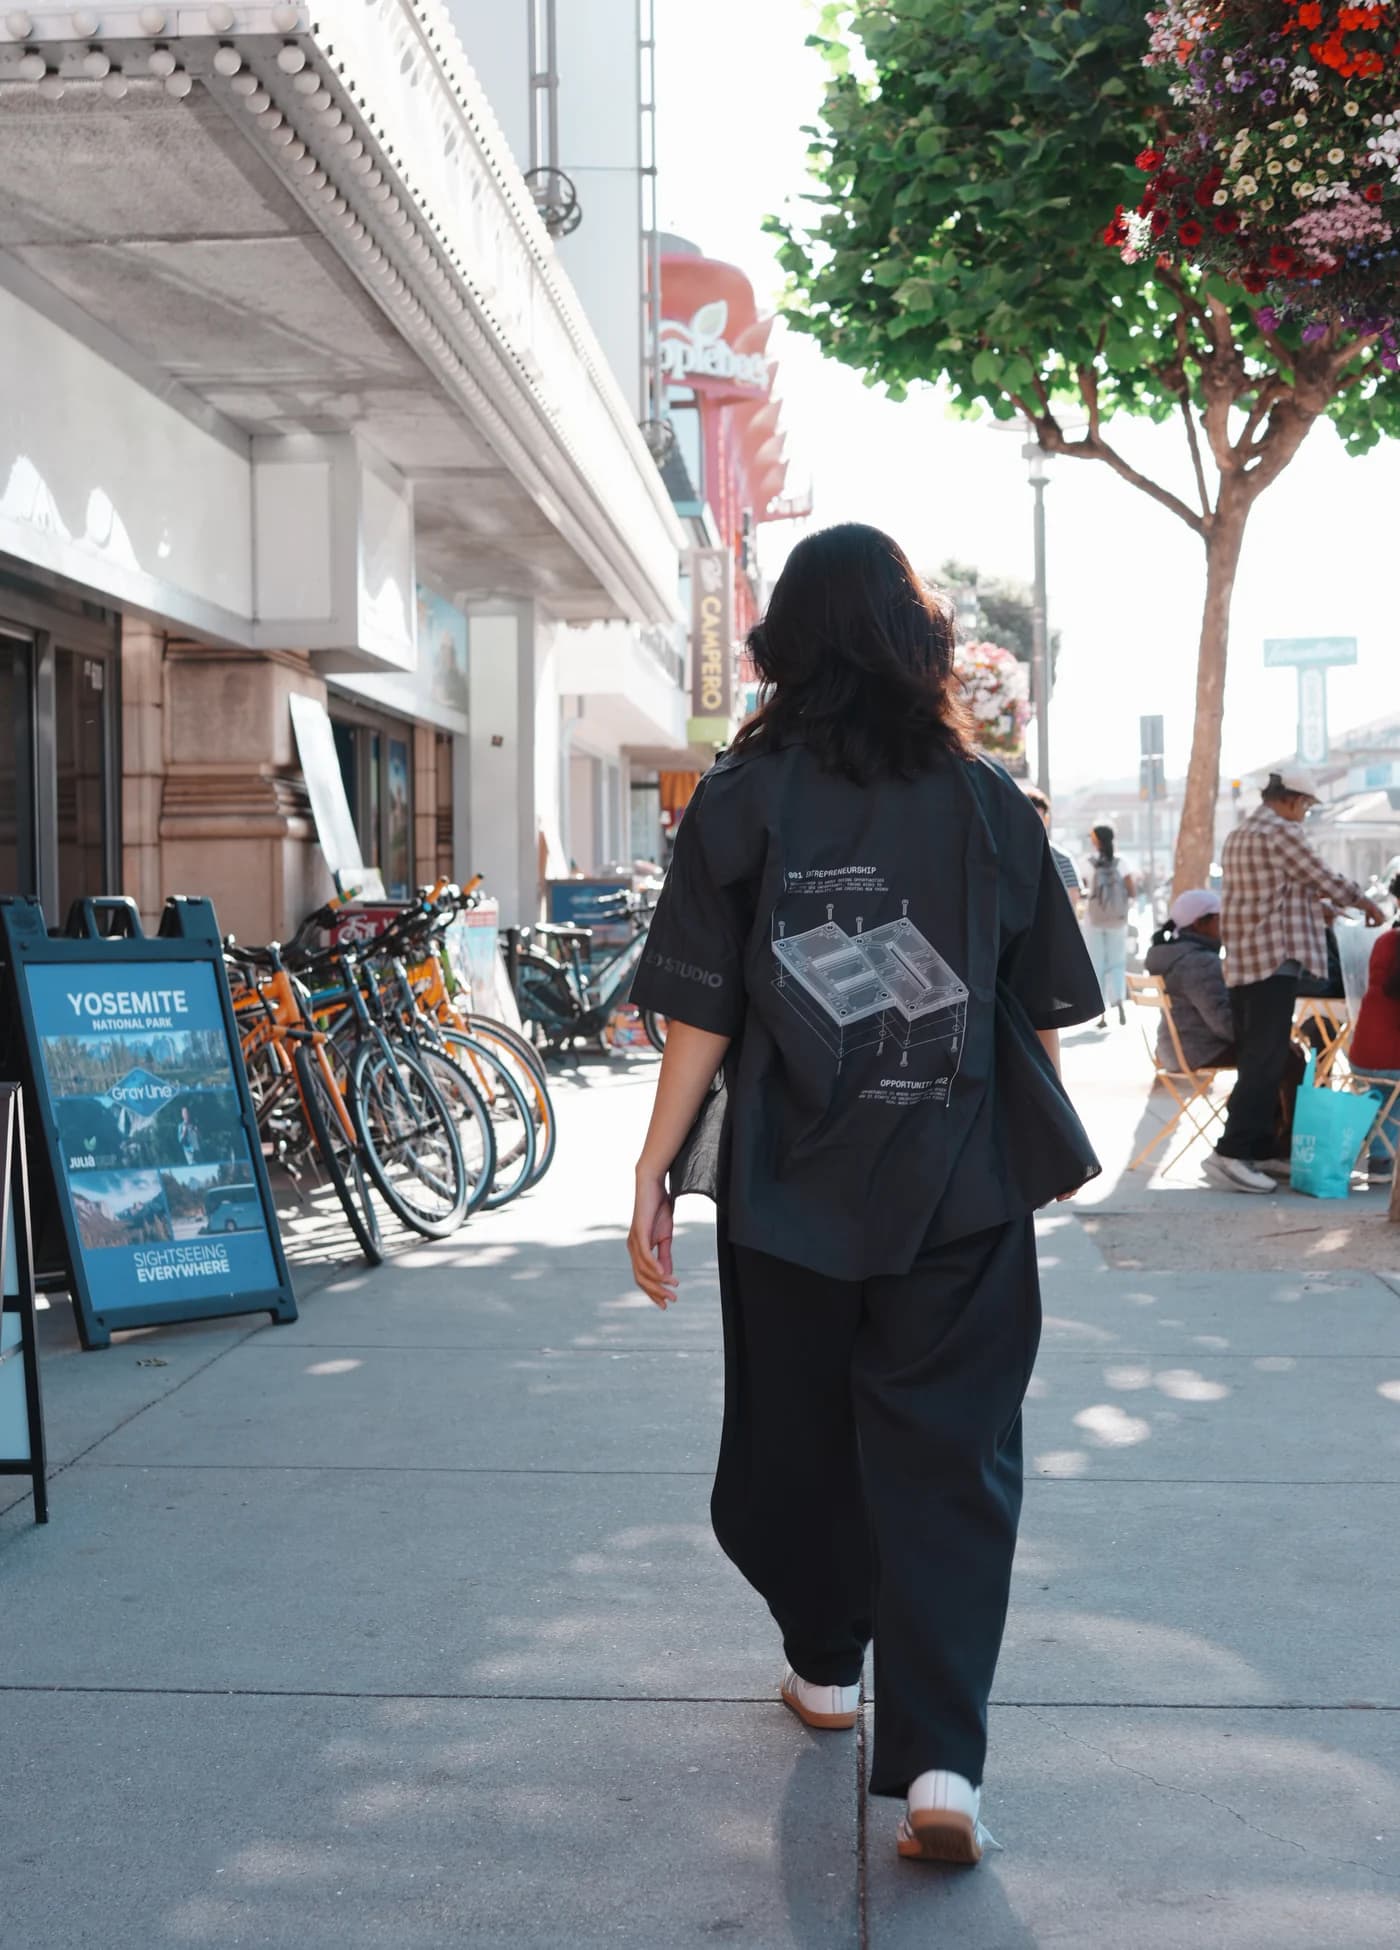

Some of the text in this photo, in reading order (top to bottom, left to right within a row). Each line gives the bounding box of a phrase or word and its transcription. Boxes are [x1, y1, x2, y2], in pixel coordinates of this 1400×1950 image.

[701, 595, 722, 710] CAMPERO
[67, 990, 188, 1016] YOSEMITE
[92, 1017, 173, 1031] NATIONAL PARK
[133, 1243, 227, 1268] SIGHTSEEING
[136, 1259, 230, 1283] EVERYWHERE
